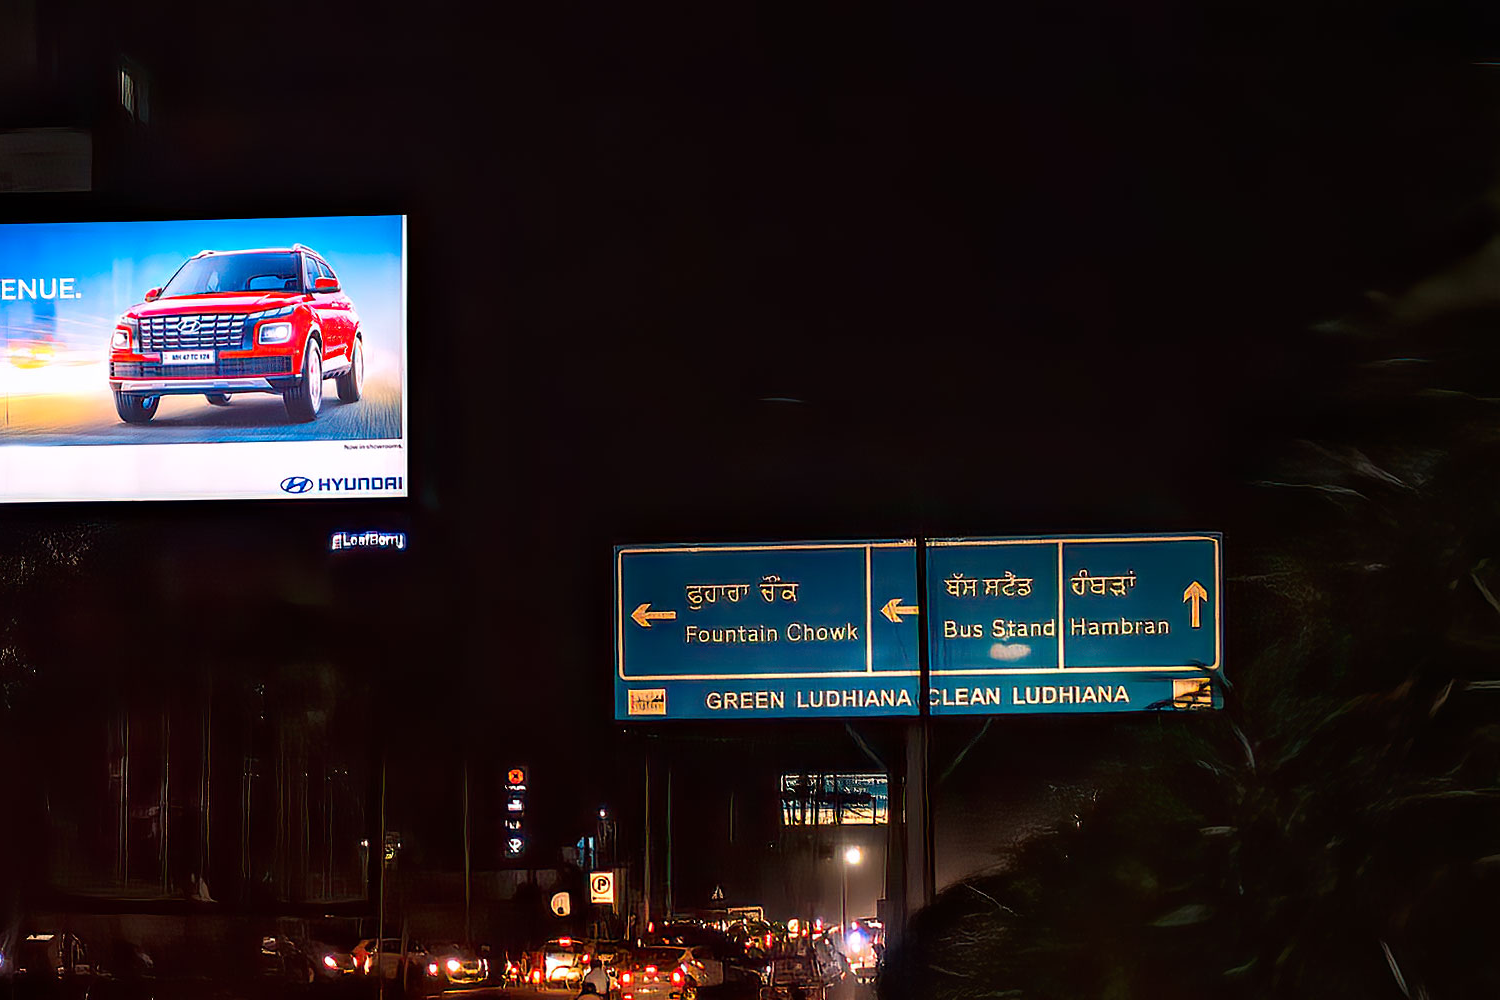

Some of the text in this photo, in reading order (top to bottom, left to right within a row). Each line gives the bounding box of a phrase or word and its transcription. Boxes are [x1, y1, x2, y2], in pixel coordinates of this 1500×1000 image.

[318, 476, 403, 491] HYUNDAI
[685, 622, 859, 643] Fountain Chowk
[943, 618, 1055, 638] Bus Stand
[1070, 617, 1170, 636] Hambran
[706, 685, 1130, 710] GREEN LUDHIANA CLEAN LUDHIANA
[597, 878, 607, 891] P
